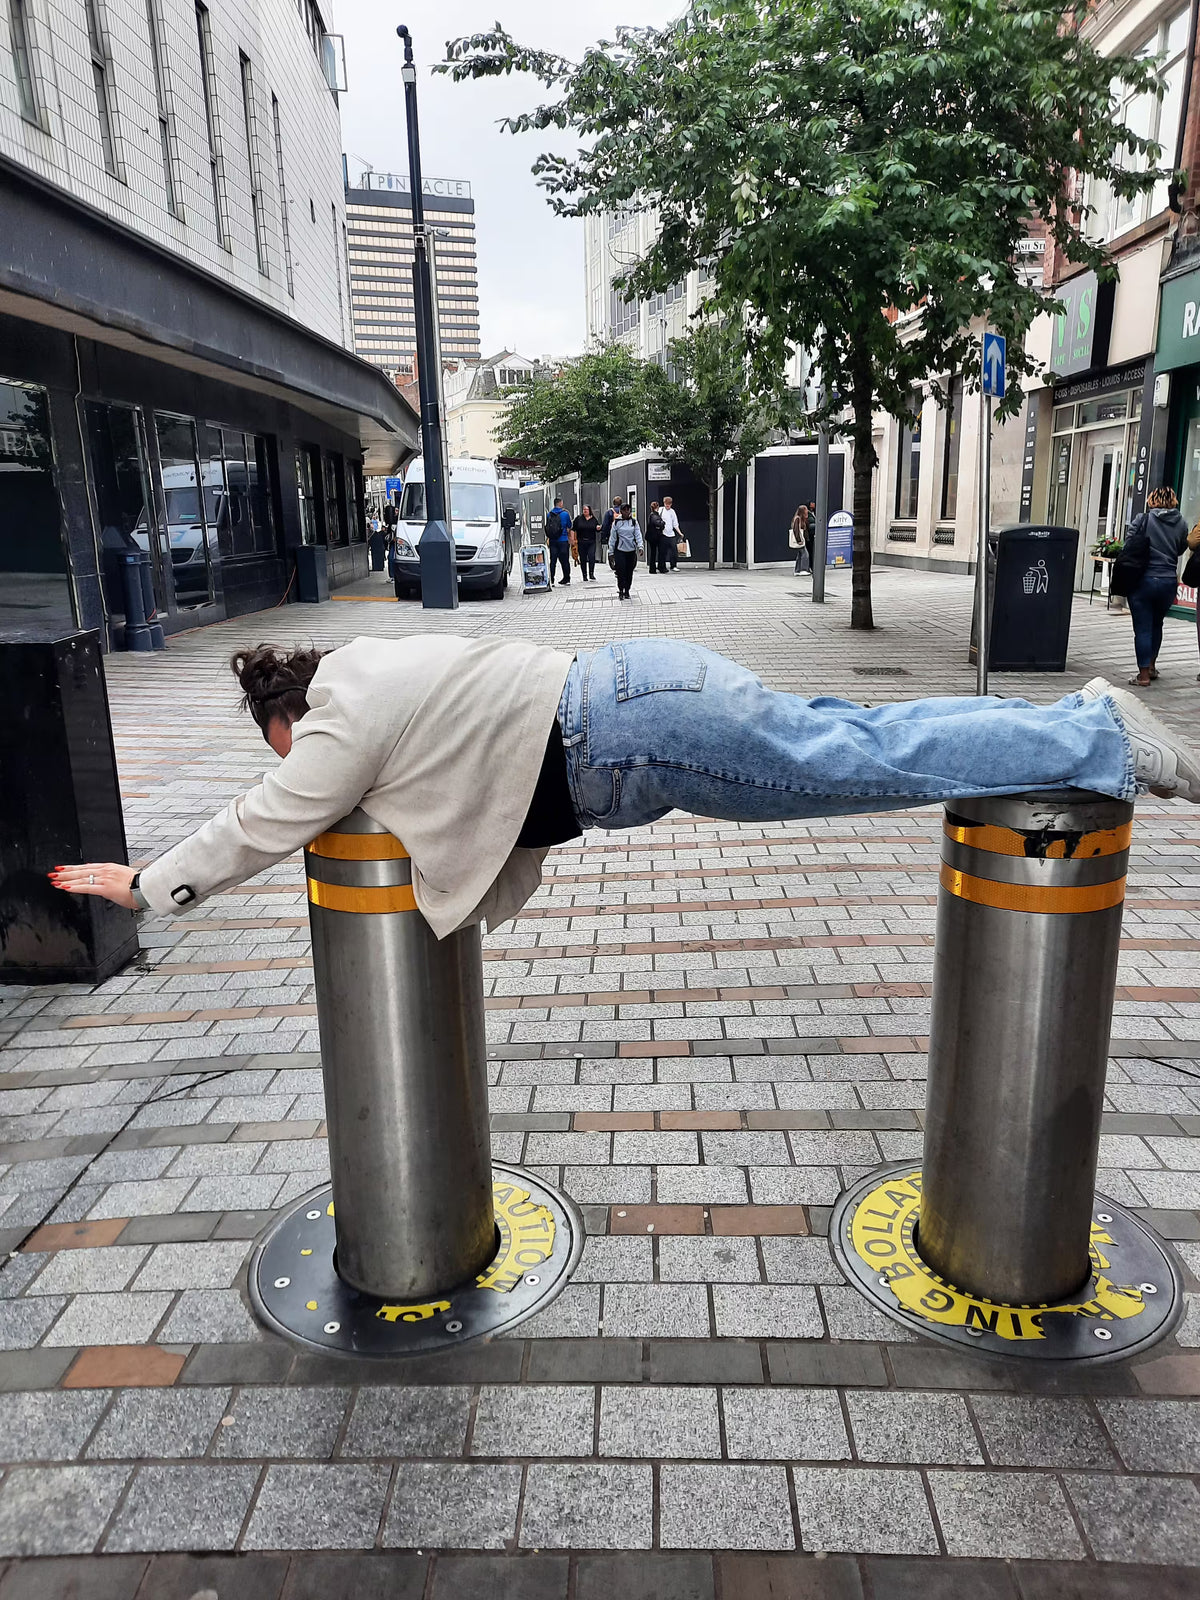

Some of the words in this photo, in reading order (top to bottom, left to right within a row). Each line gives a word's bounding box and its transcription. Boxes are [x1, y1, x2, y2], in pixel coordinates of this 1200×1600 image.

[378, 173, 463, 195] PINACLE
[1076, 287, 1093, 340] S
[1070, 379, 1099, 396] DISPOSABLES
[1102, 373, 1121, 388] LIQUIDS
[1176, 585, 1198, 603] SALE
[493, 1187, 549, 1291] AUTION
[862, 1178, 922, 1281] BOLLA
